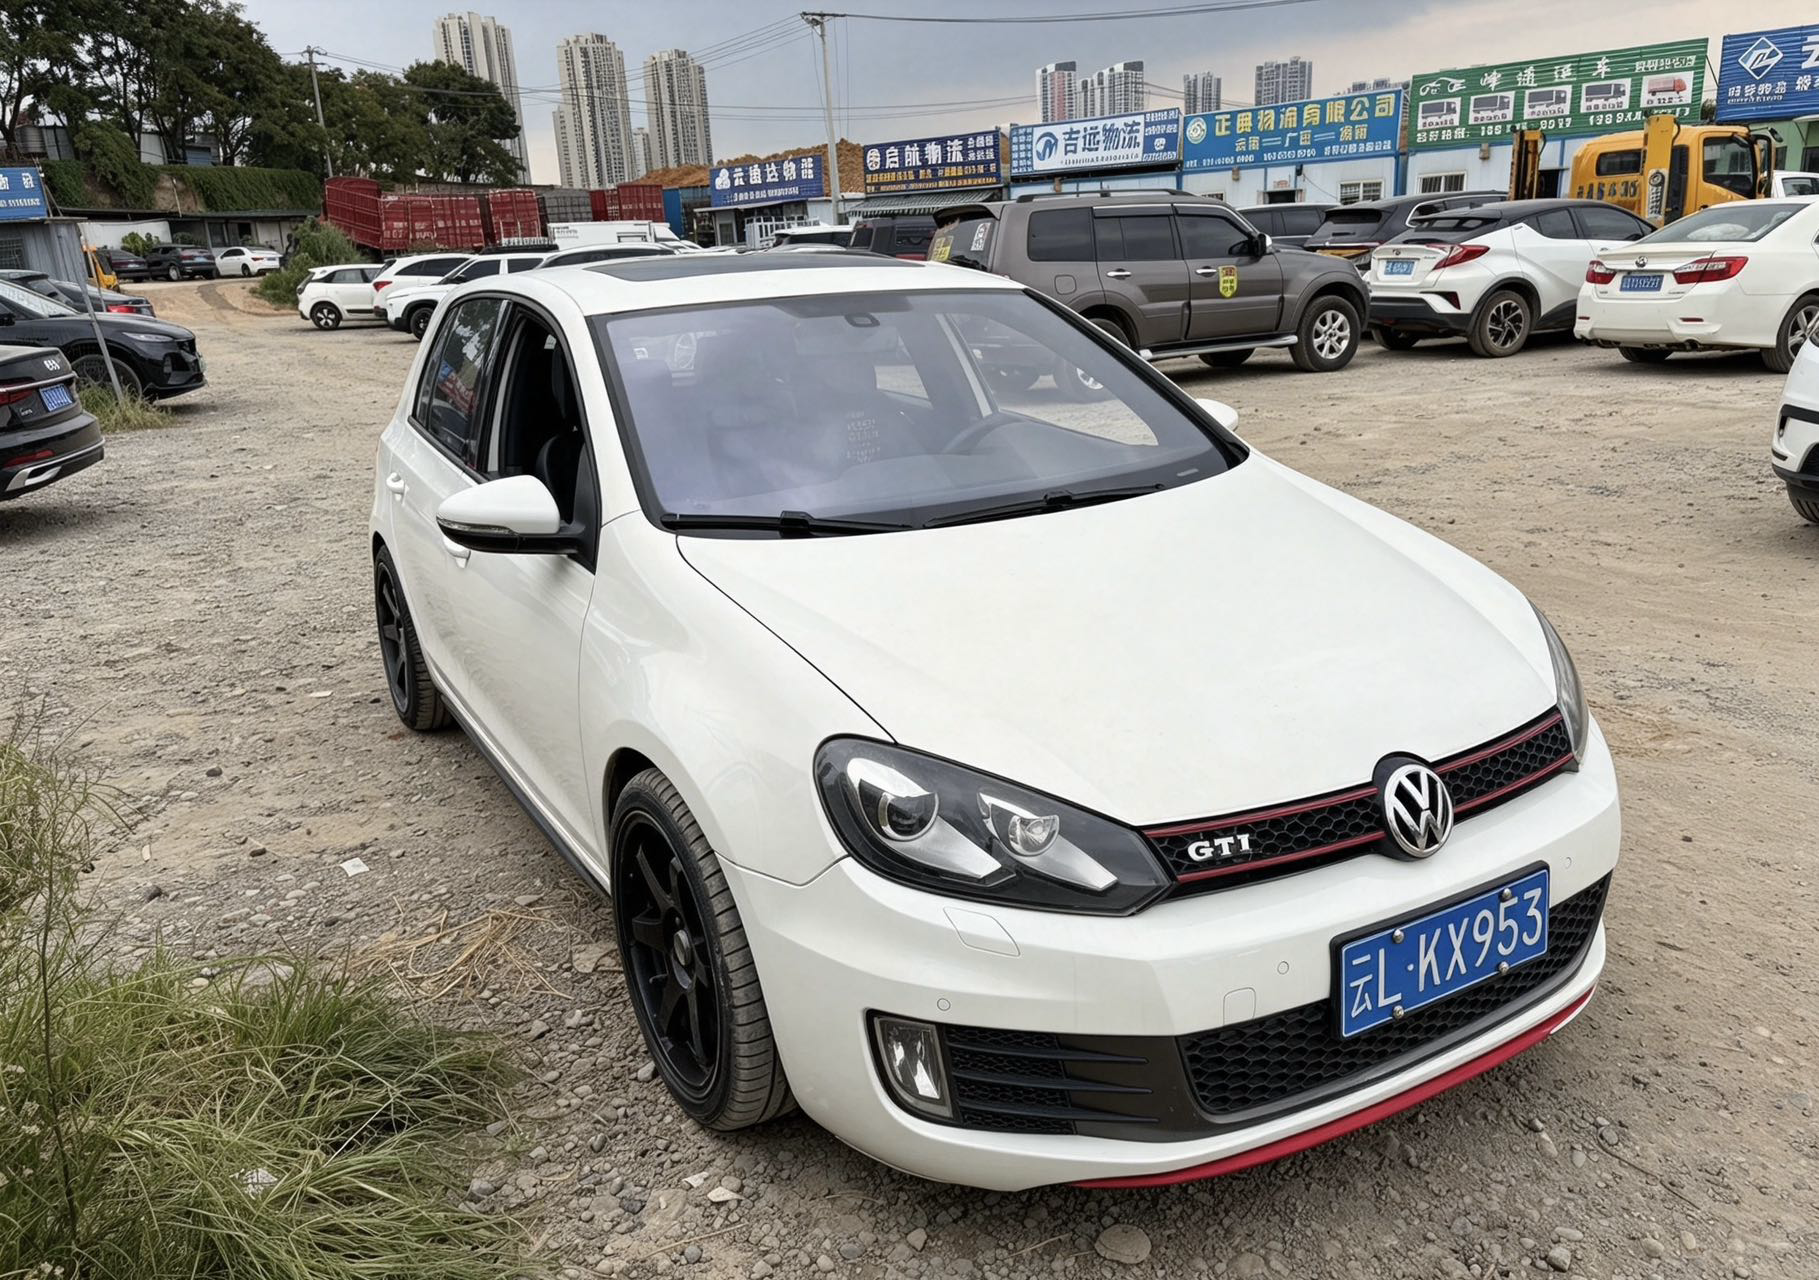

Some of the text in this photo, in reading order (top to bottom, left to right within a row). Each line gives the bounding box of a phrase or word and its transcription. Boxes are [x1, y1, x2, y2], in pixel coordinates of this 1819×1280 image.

[1062, 120, 1141, 156] 吉远物流
[1187, 833, 1250, 862] GTI
